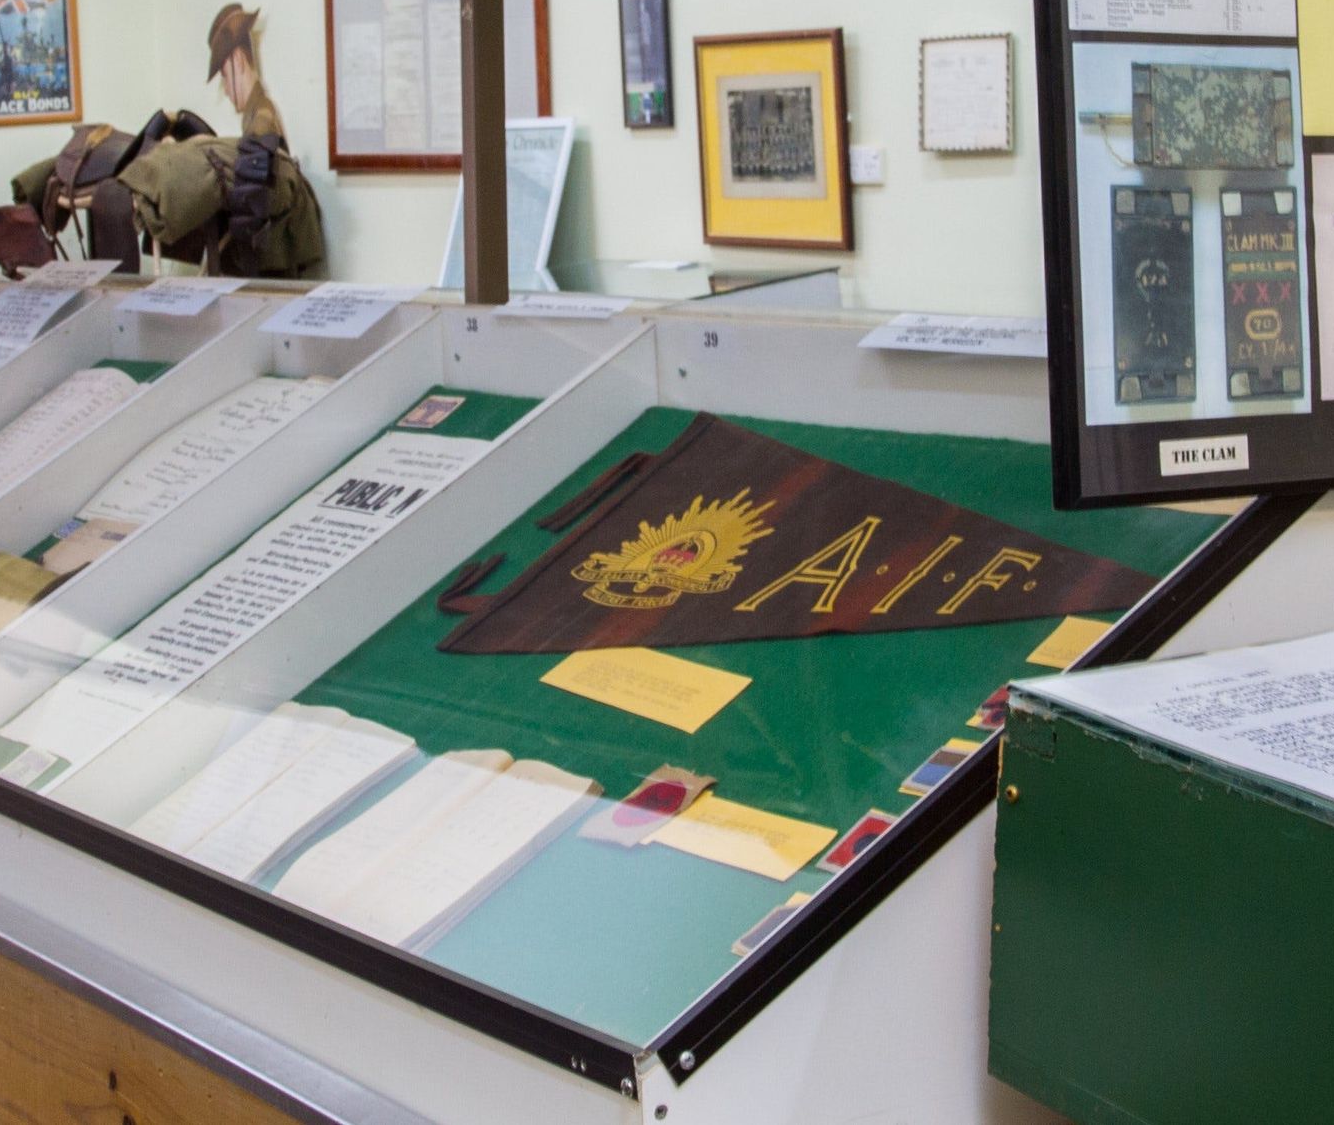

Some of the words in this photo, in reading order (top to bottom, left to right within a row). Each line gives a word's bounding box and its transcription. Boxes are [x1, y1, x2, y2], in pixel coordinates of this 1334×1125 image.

[28, 96, 69, 112] BONDS
[1228, 234, 1258, 252] CLAM
[704, 332, 718, 348] 39
[1172, 449, 1199, 465] THE
[1202, 446, 1236, 462] CLAM
[322, 478, 405, 512] PUBLIC
